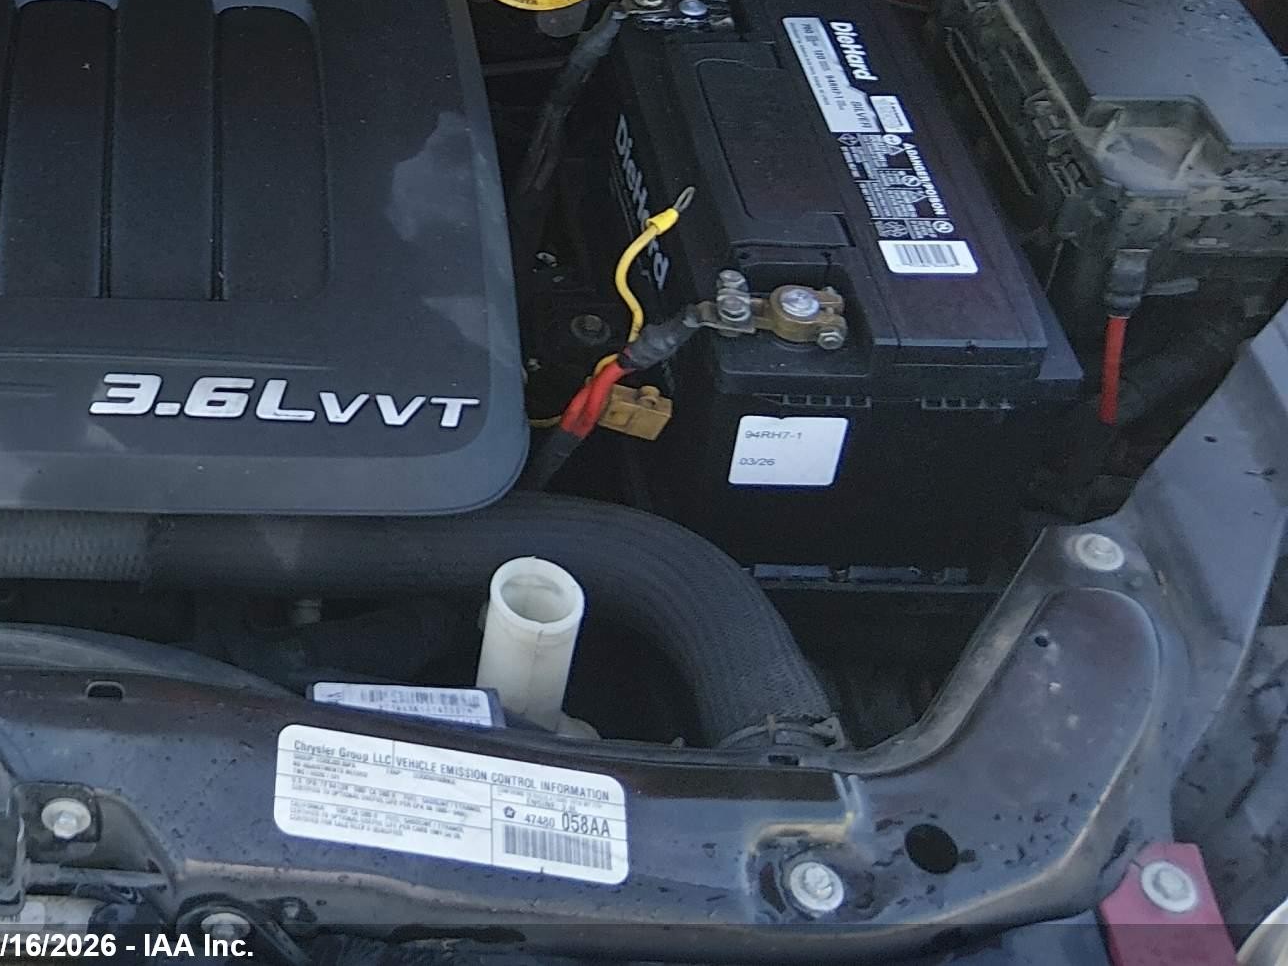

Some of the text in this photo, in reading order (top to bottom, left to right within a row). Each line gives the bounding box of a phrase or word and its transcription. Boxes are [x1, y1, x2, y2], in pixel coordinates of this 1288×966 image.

[829, 21, 879, 81] DieHard
[850, 101, 873, 129] SILVER
[744, 429, 803, 440] 94RH7-1
[294, 740, 335, 757] Chrysler
[339, 747, 369, 763] Group
[373, 753, 392, 765] LLC
[396, 757, 436, 772] VEHICLE
[440, 764, 488, 781] EMISSION
[491, 772, 536, 789] CONTROL
[540, 781, 610, 801] INFORMATION
[561, 811, 611, 837] 058AA
